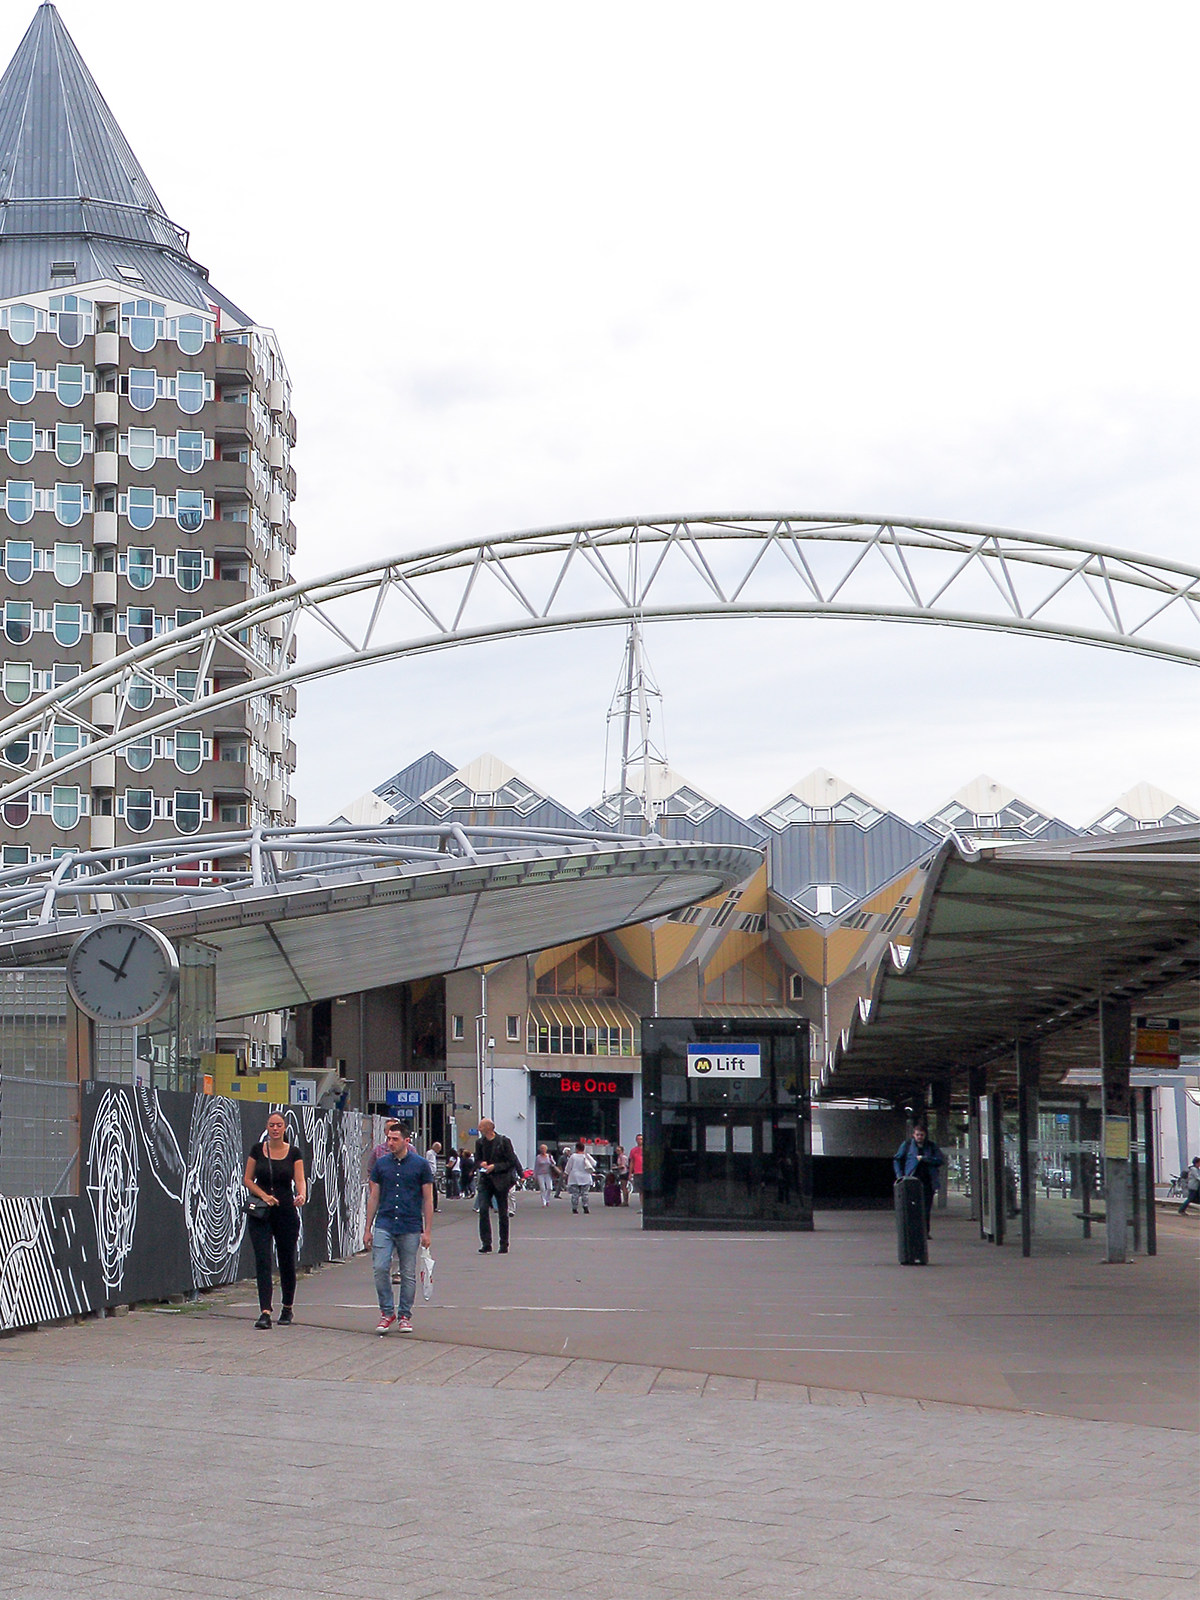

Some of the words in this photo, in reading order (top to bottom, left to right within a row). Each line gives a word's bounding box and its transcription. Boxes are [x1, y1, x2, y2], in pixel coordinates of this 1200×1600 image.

[716, 1057, 746, 1071] Lift
[561, 1078, 580, 1092] Be
[584, 1078, 617, 1093] One
